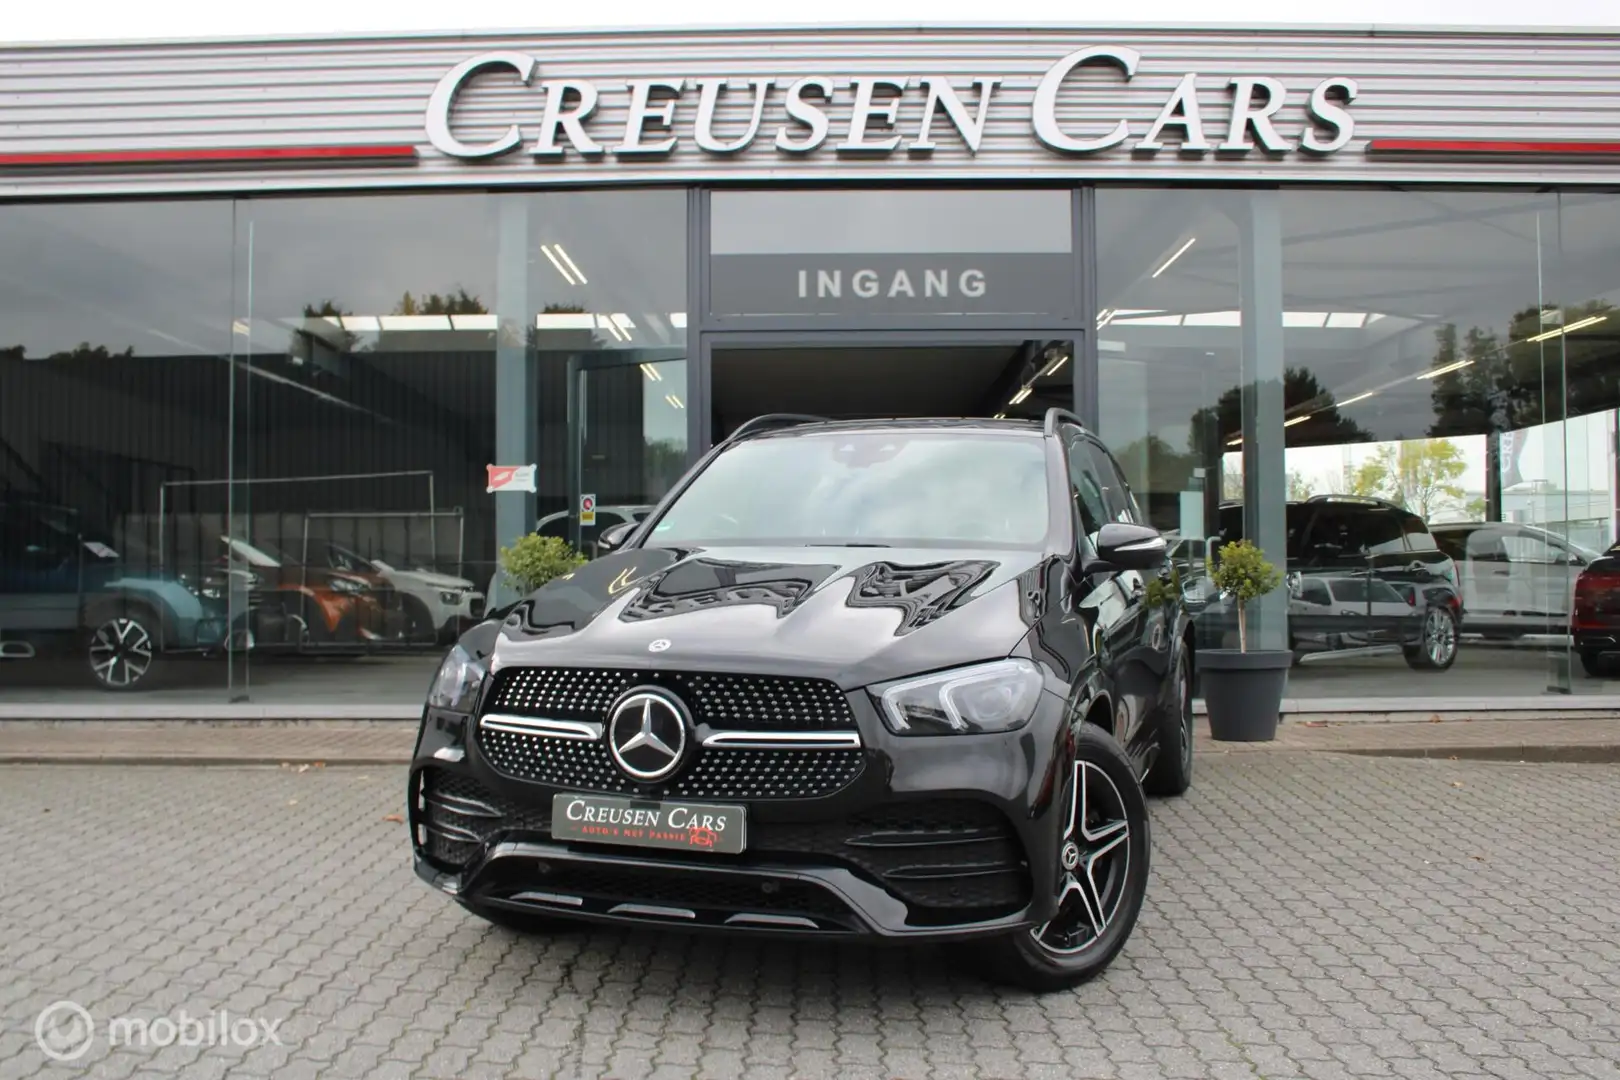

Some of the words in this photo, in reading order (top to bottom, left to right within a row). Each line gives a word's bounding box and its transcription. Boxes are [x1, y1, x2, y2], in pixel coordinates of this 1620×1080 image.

[425, 51, 1002, 160] CREUSEN
[1032, 45, 1358, 157] CARS
[799, 269, 986, 298] INGANG
[566, 800, 660, 827] CREUSEN
[668, 807, 727, 832] CARS
